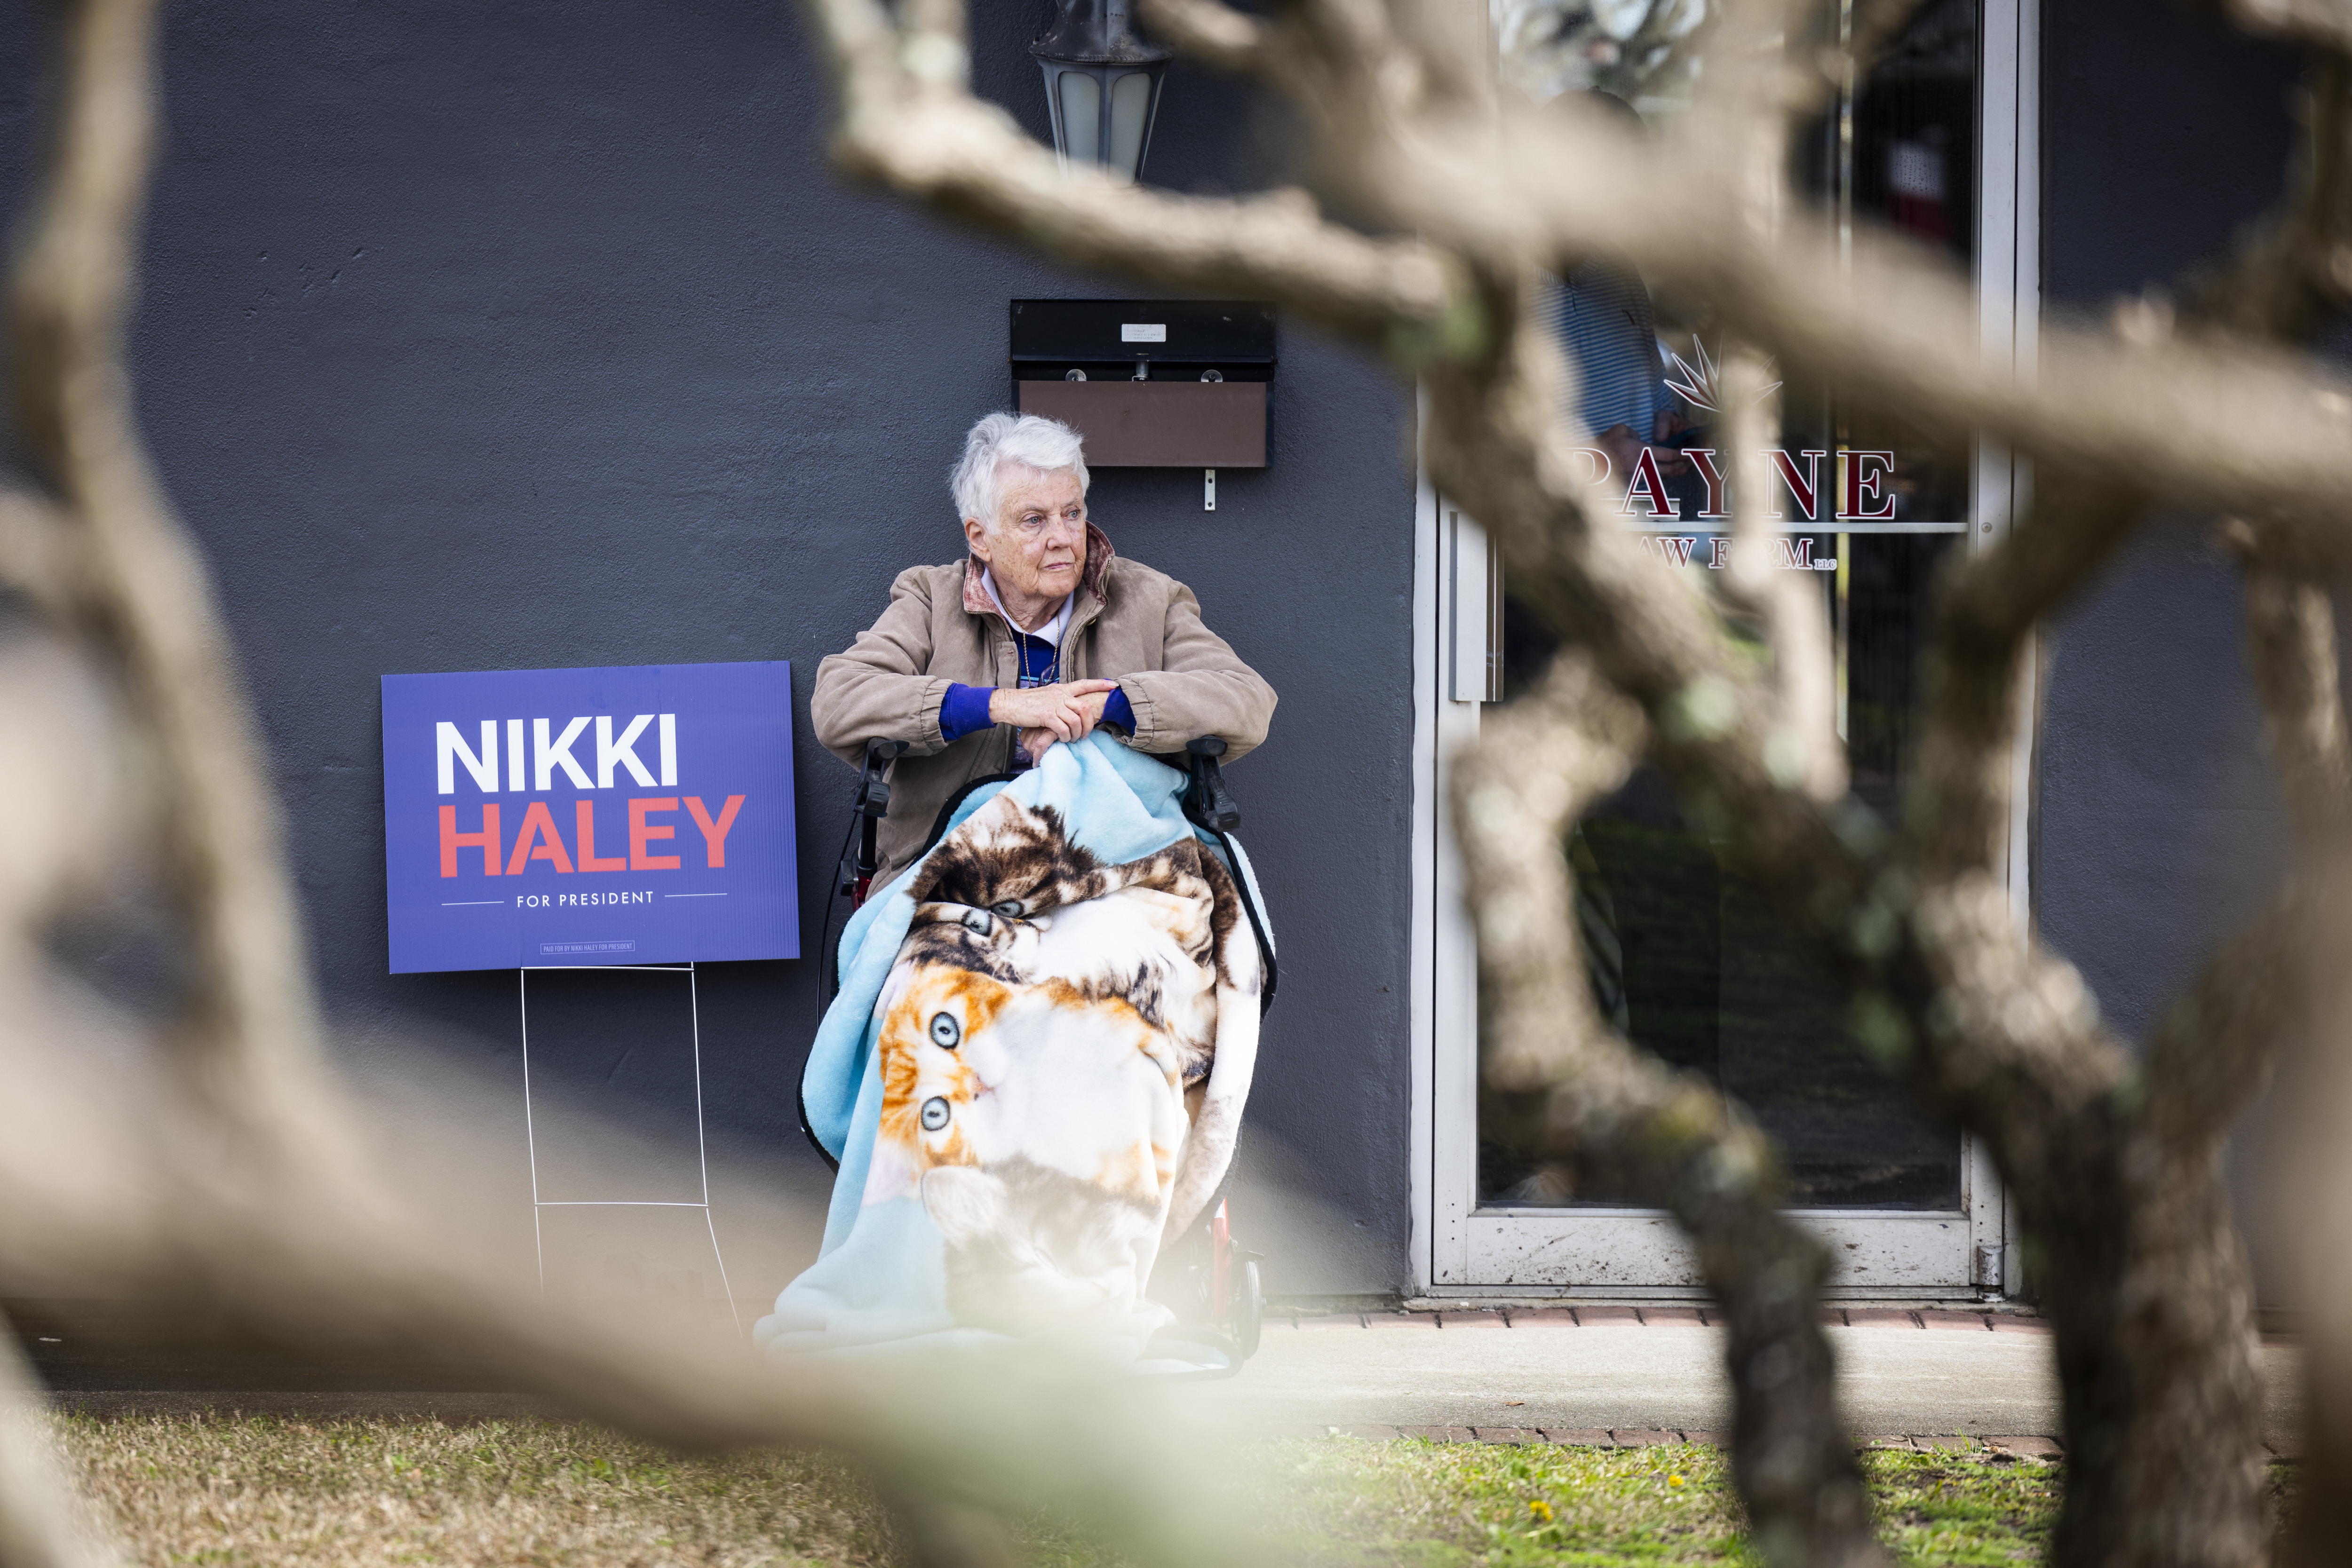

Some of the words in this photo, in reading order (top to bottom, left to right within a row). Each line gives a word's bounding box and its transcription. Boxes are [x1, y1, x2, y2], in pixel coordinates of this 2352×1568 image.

[1636, 536, 1696, 569] AW
[1708, 538, 1813, 570] FRM
[1814, 559, 1837, 570] LLC
[436, 713, 677, 794] NIKKI
[438, 794, 747, 878] HALEY
[516, 895, 550, 908] FOR
[559, 891, 654, 906] PRESIDENT
